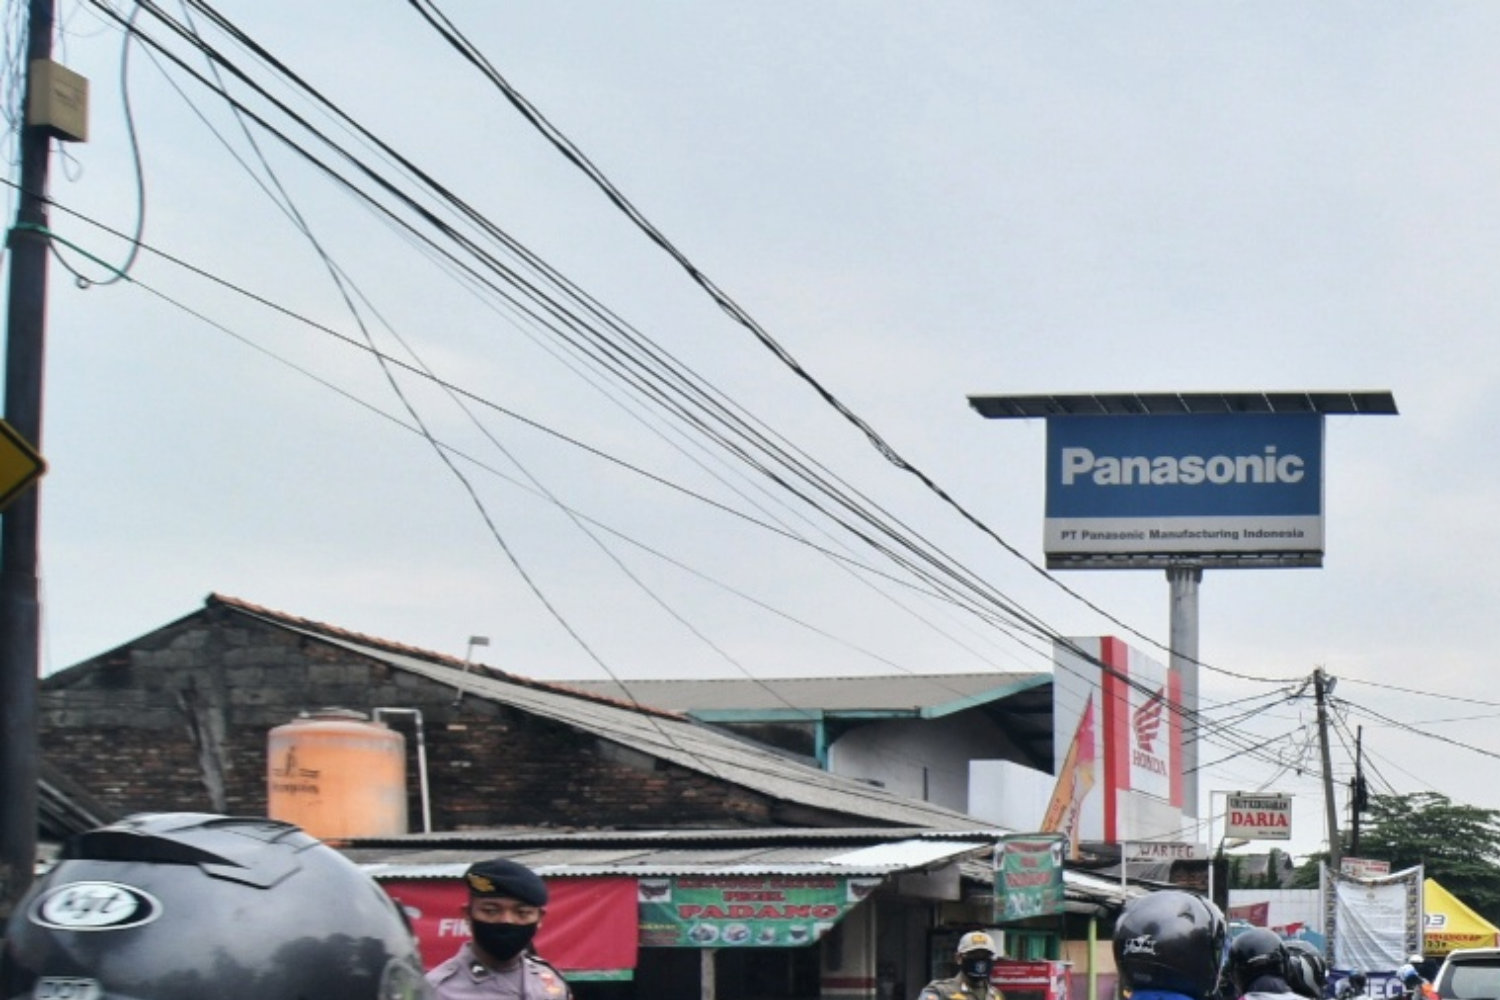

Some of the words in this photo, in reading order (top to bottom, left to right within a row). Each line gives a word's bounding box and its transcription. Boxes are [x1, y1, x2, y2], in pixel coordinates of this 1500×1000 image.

[1062, 445, 1304, 485] Panasonic
[1061, 530, 1077, 540] PT
[1081, 530, 1145, 540] Panasonic
[1149, 529, 1239, 540] Manufacturing
[1243, 528, 1305, 539] Indonesia
[1133, 750, 1167, 777] HONDA
[1231, 812, 1288, 827] DARIA
[1139, 844, 1194, 858] WARTEG
